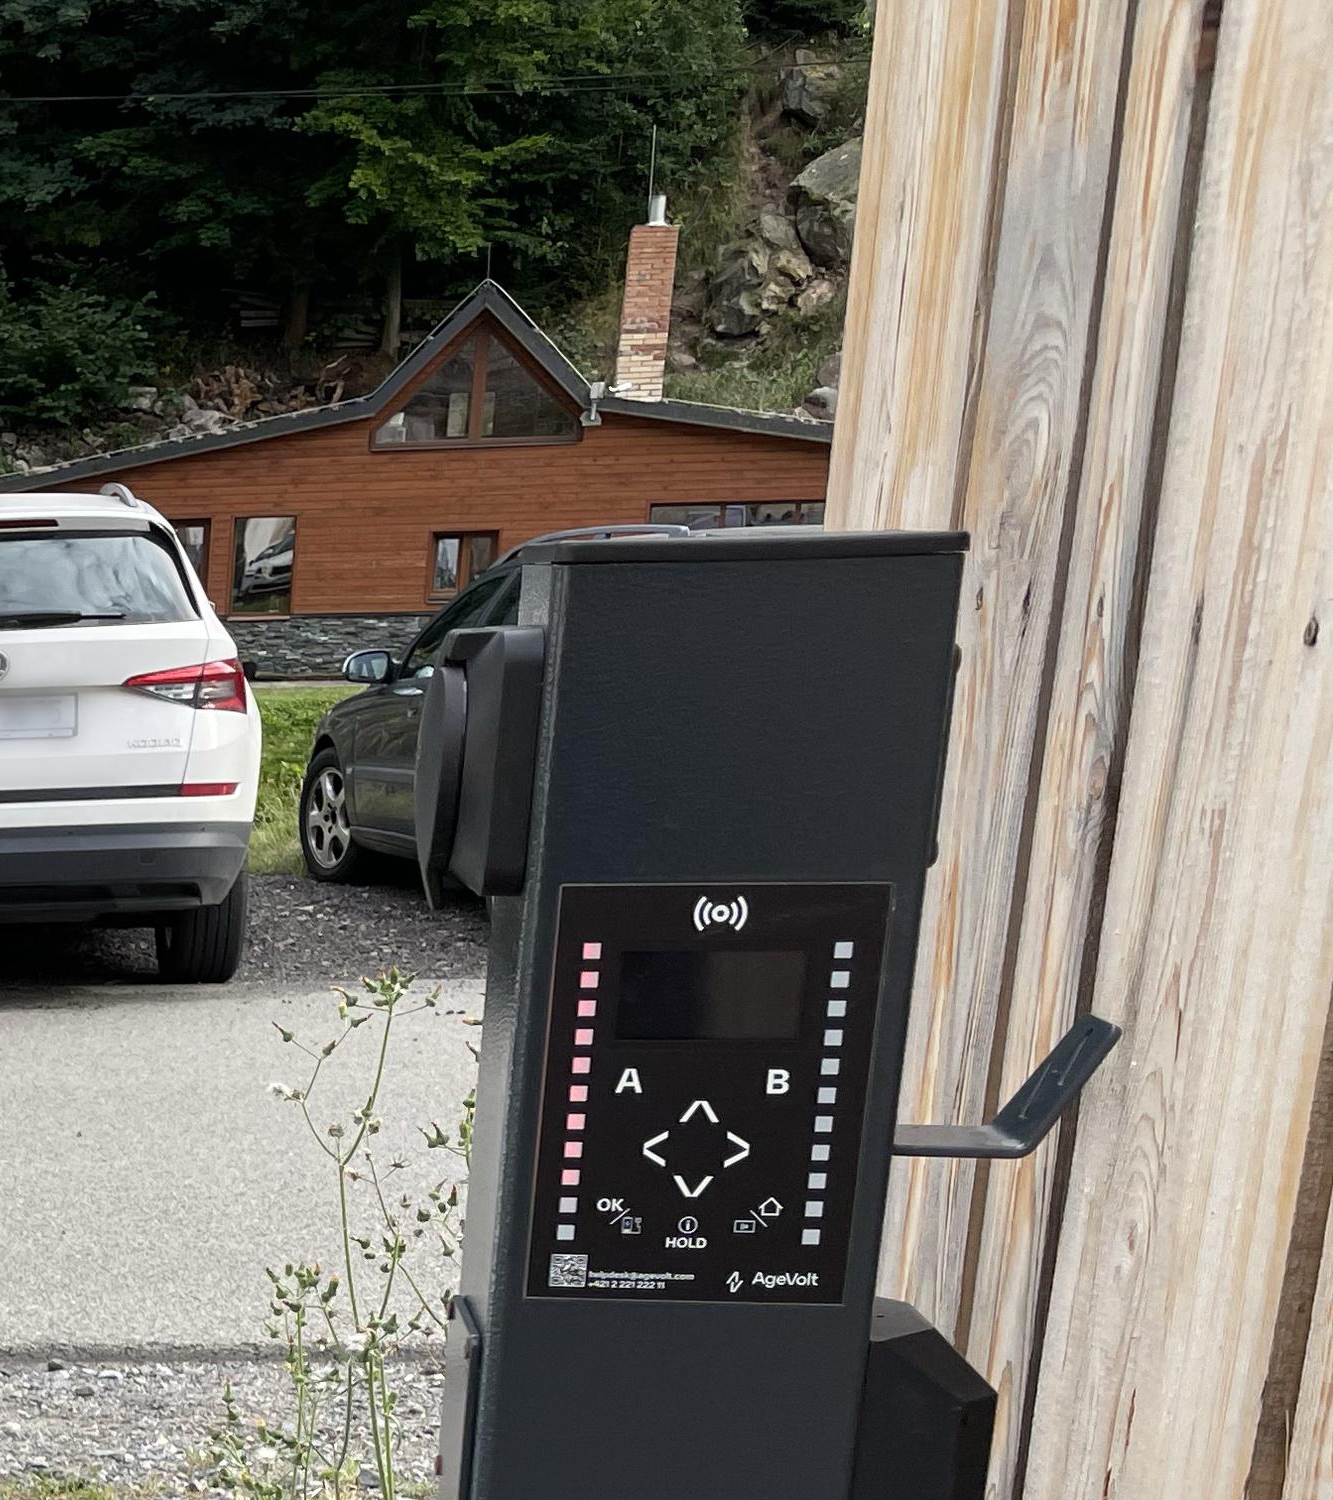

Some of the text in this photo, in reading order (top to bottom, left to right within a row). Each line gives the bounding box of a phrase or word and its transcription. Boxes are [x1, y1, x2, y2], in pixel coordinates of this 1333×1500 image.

[615, 1068, 643, 1094] A
[766, 1069, 790, 1095] B
[596, 1198, 624, 1212] OK
[665, 1236, 708, 1250] HOLD
[751, 1271, 820, 1289] AgeVolt
